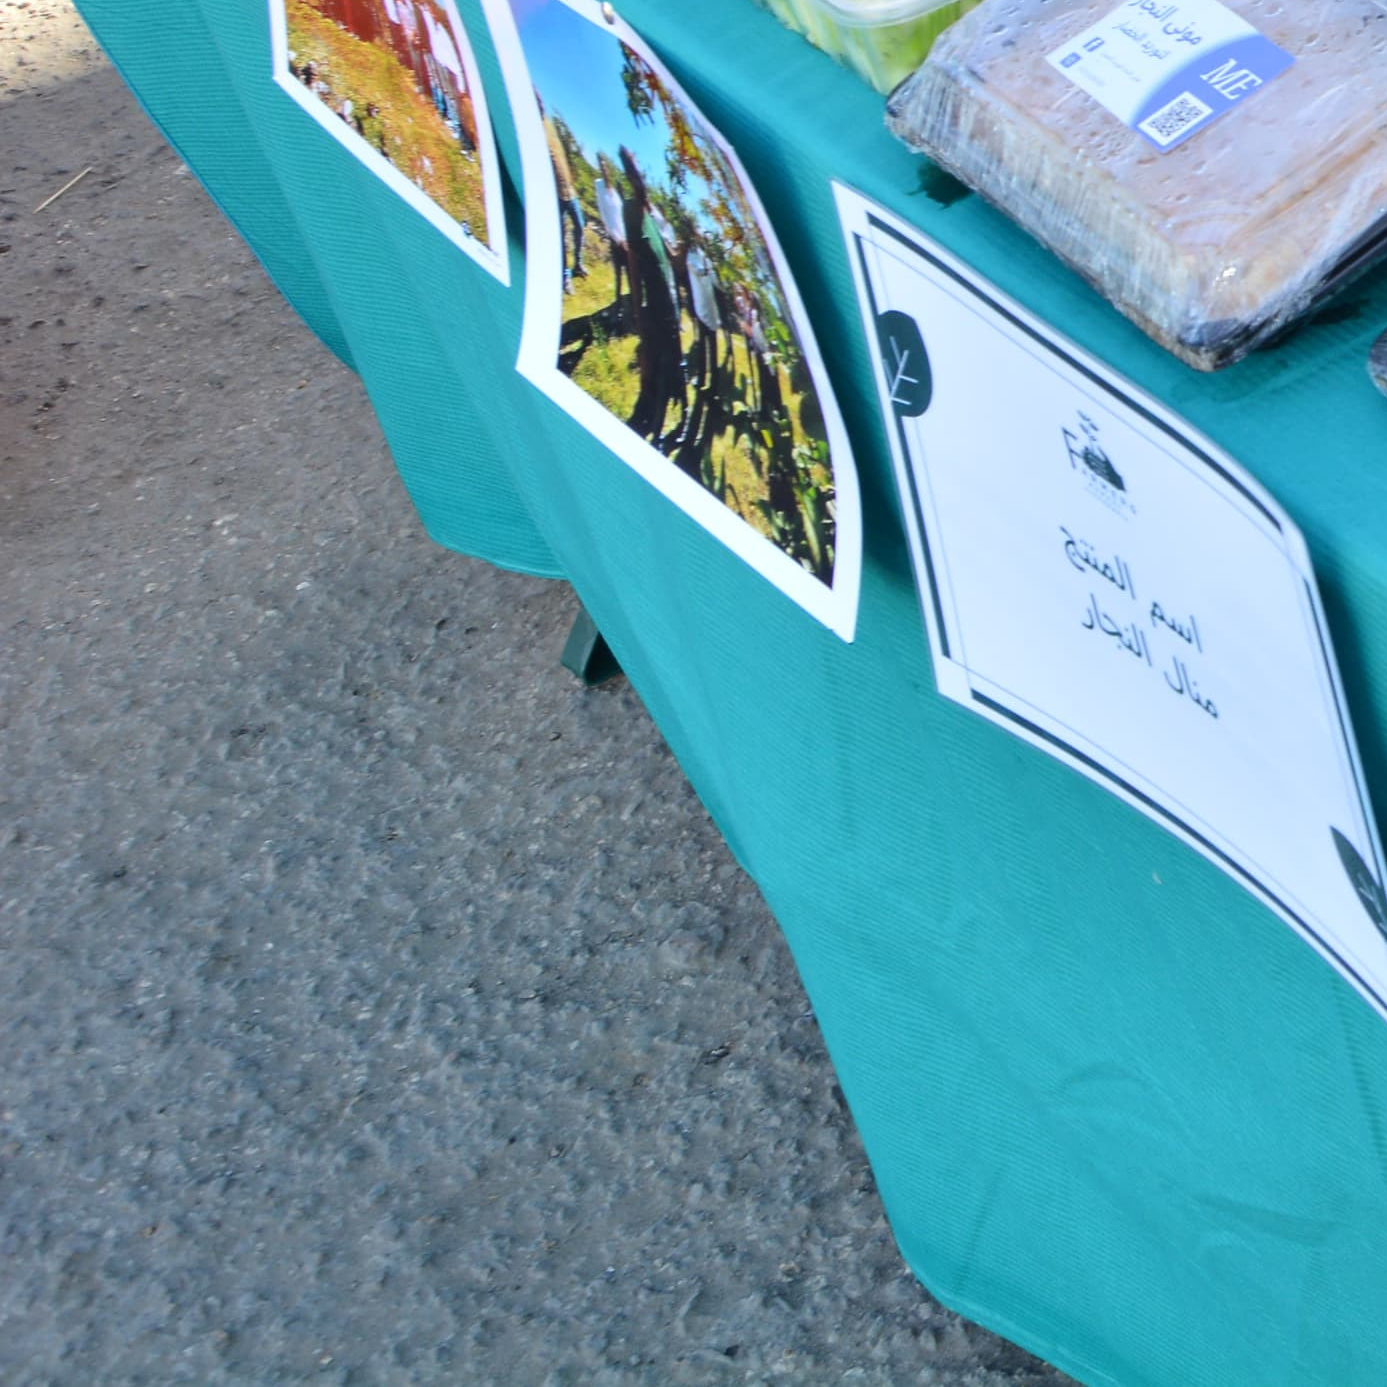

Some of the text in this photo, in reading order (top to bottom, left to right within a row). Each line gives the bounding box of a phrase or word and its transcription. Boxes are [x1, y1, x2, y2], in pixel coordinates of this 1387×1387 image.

[1200, 57, 1264, 101] ME
[1059, 525, 1203, 654] اسم المنتج
[1081, 591, 1220, 720] منال النجار
